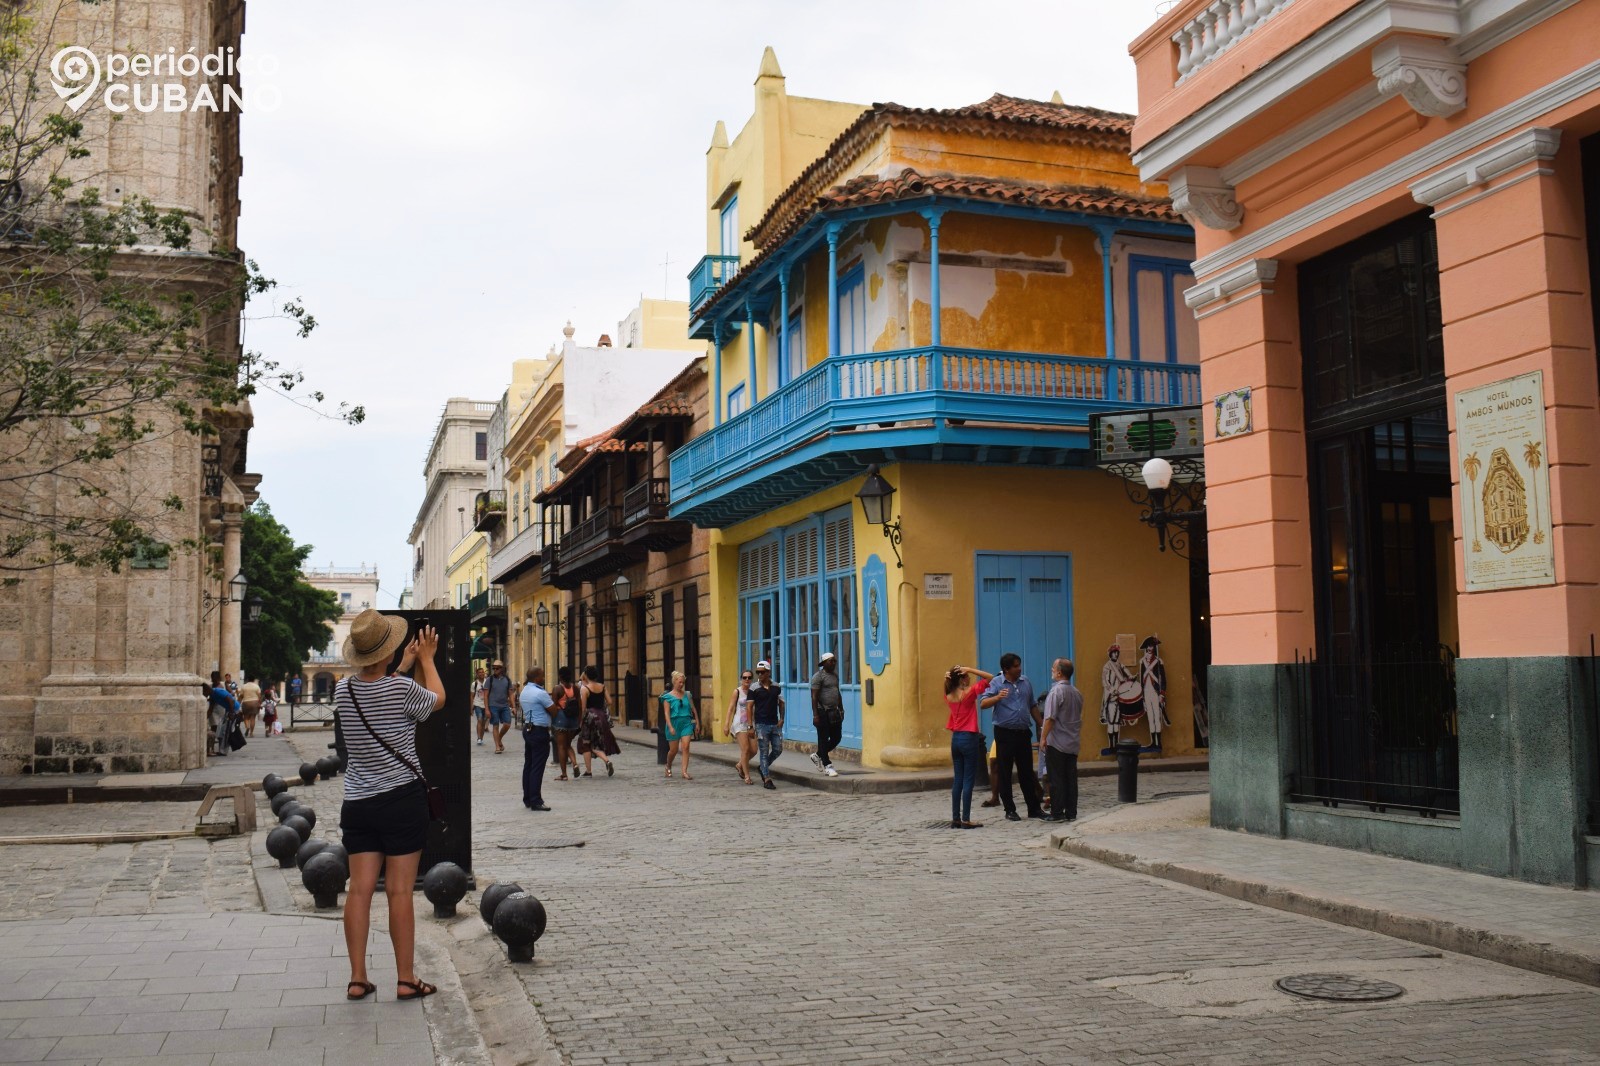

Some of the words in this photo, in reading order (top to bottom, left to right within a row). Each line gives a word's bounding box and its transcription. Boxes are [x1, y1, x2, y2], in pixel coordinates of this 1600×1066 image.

[1487, 391, 1509, 402] HOTEL
[1226, 401, 1239, 410] CALLE
[1466, 405, 1493, 419] AMBOS
[1497, 395, 1533, 412] MUNDOS
